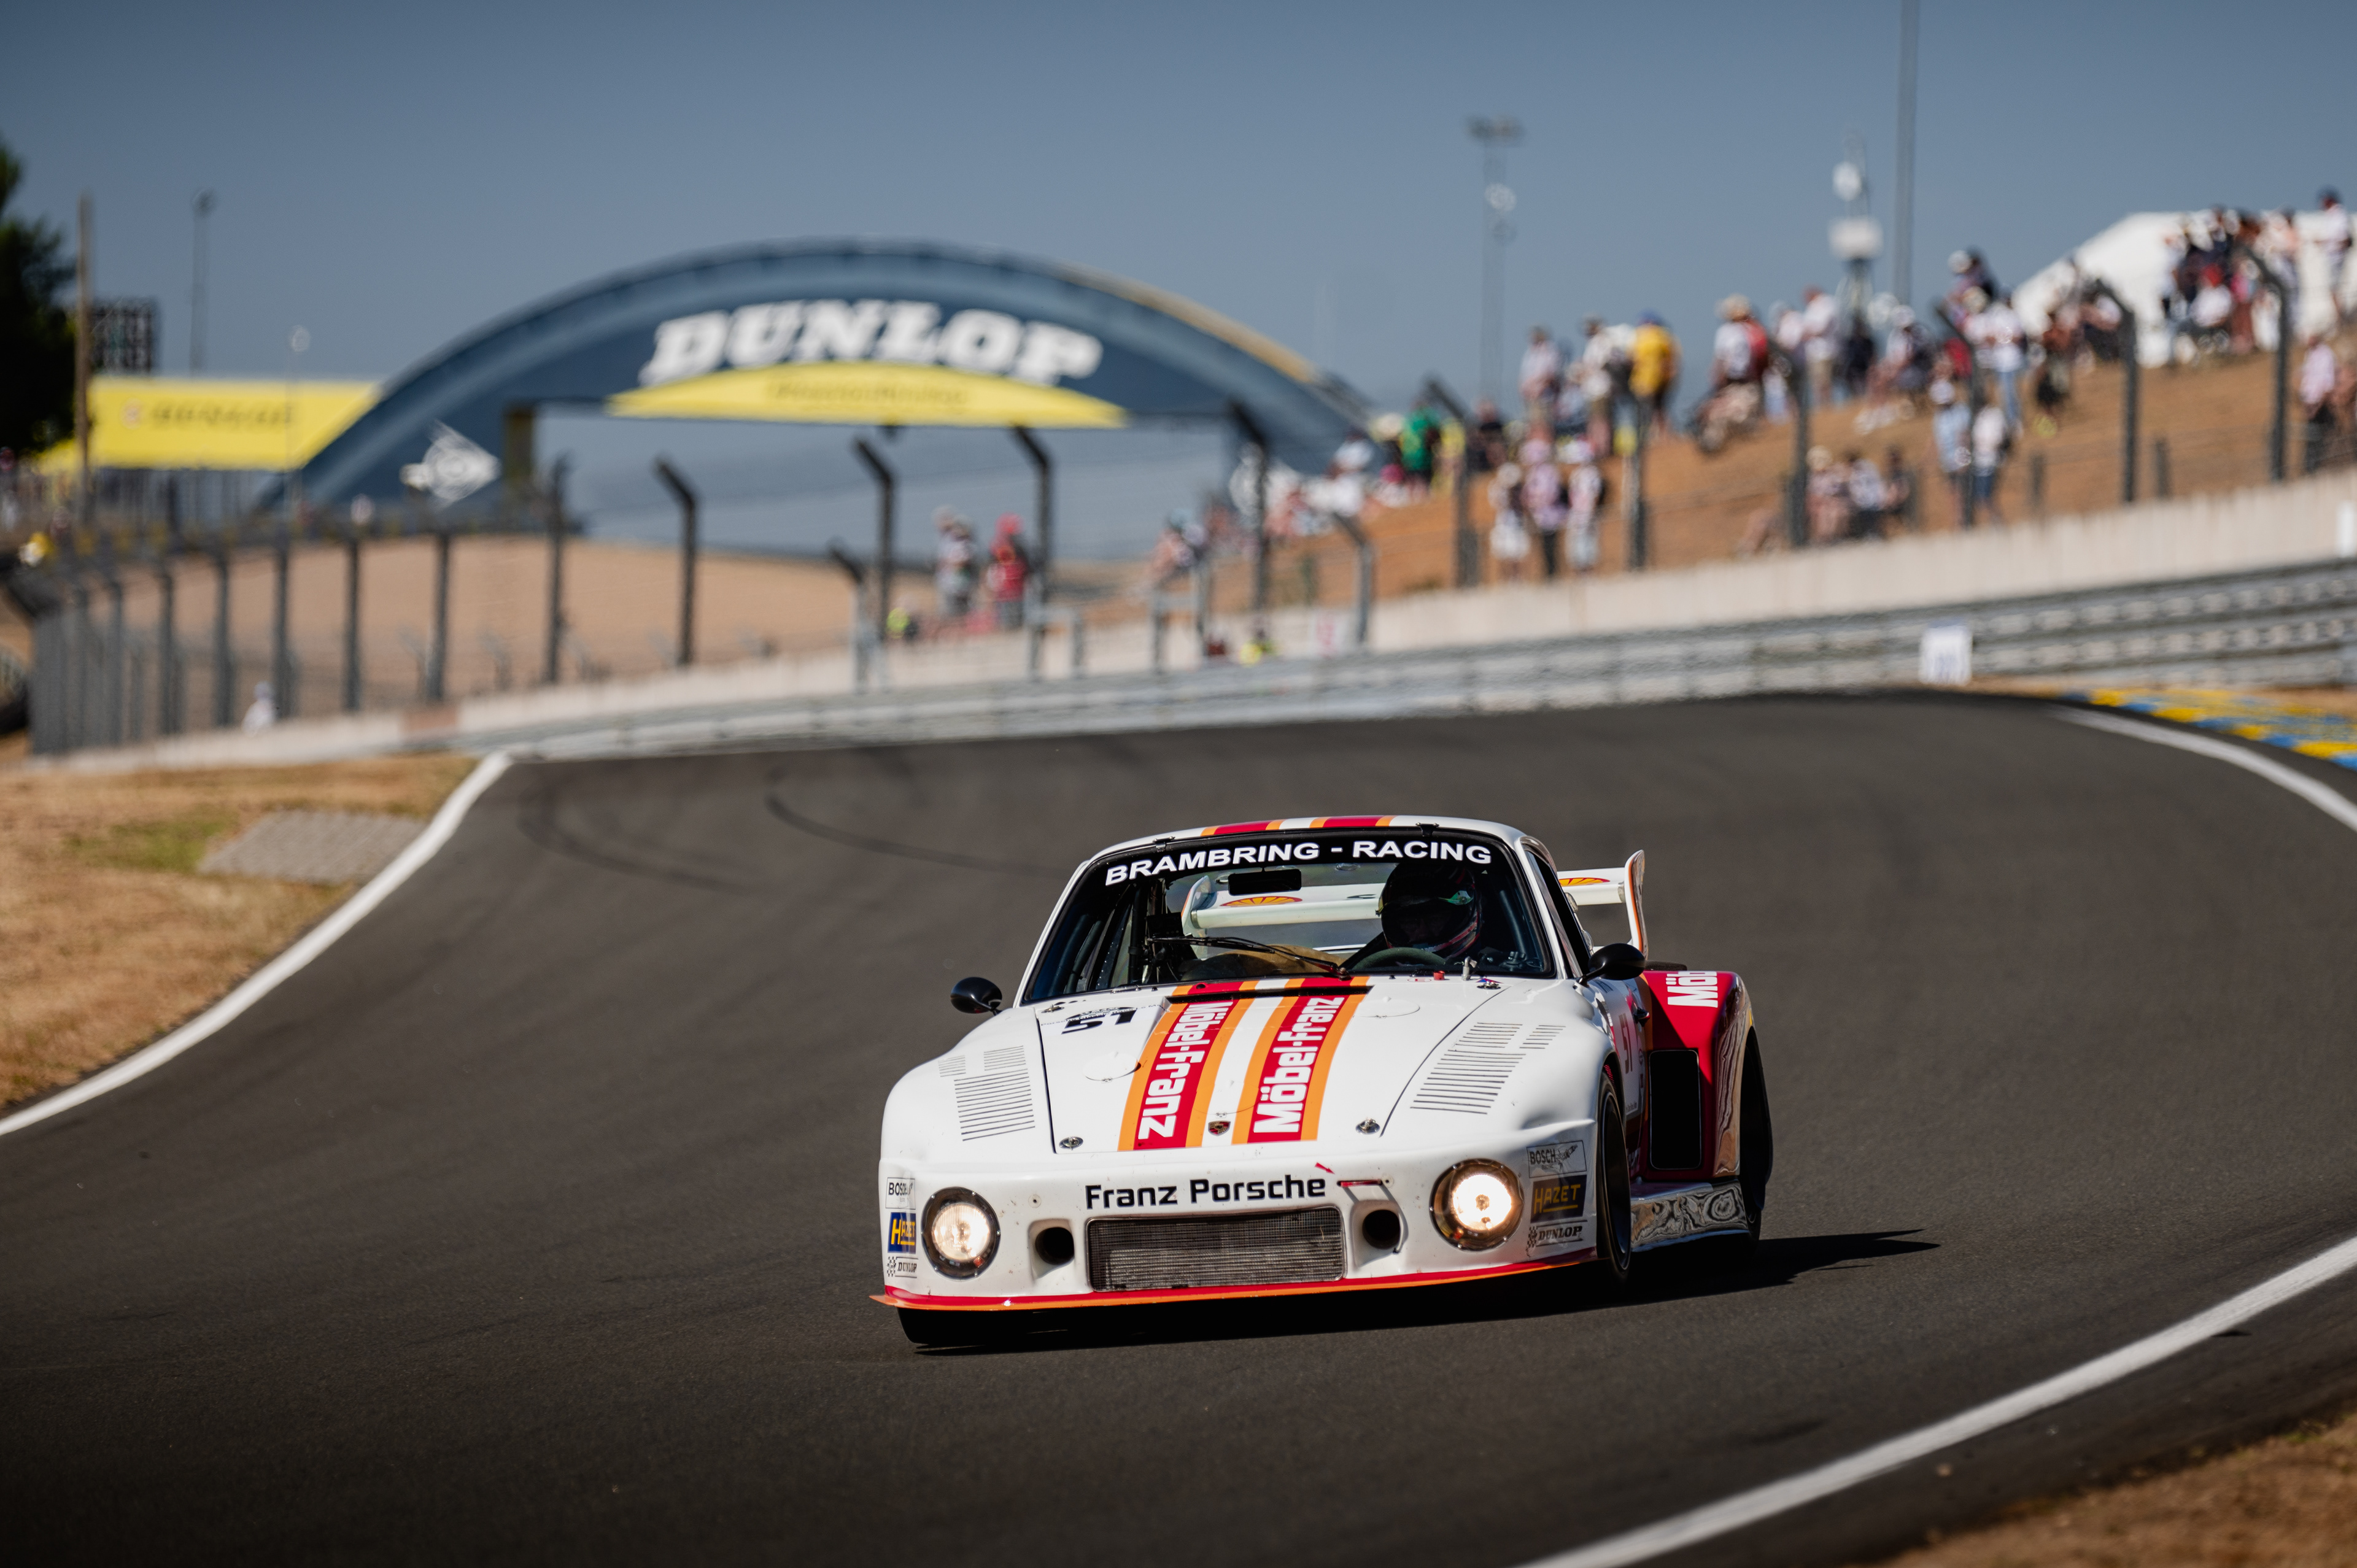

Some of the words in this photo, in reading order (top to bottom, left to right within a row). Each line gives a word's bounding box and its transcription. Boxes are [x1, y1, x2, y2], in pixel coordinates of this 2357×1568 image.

[638, 298, 1103, 387] DUNLOP
[1105, 842, 1320, 886] BRAMBRING
[1352, 840, 1492, 864] RACING
[1061, 1010, 1137, 1035] 51
[1137, 1001, 1234, 1140] Möbel-Franz
[1253, 997, 1345, 1133] Möbel-Franz
[1529, 1148, 1557, 1165] BOSCH
[1085, 1184, 1178, 1210] Franz
[1190, 1175, 1326, 1204] Porsche
[1534, 1184, 1581, 1215] HAZET
[891, 1219, 915, 1245] HAZET
[1538, 1226, 1583, 1241] DUNLOP
[897, 1262, 917, 1273] DUNLOP
